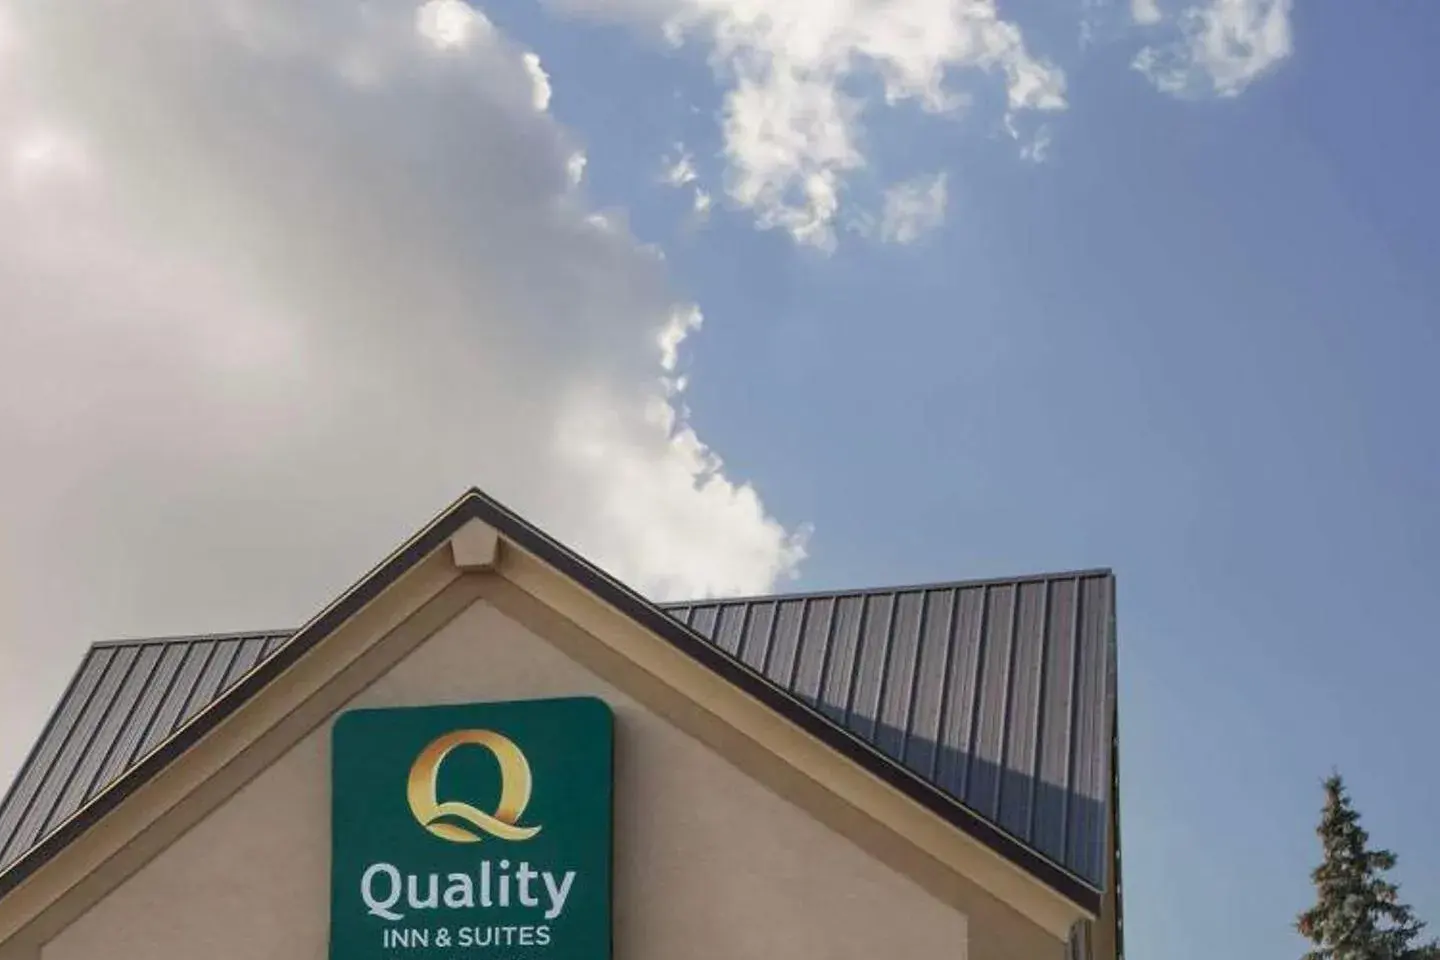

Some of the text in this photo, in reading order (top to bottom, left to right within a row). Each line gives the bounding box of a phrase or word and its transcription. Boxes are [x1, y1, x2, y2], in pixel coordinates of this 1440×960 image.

[360, 859, 577, 921] Quality
[382, 925, 551, 948] INN & SUITES
